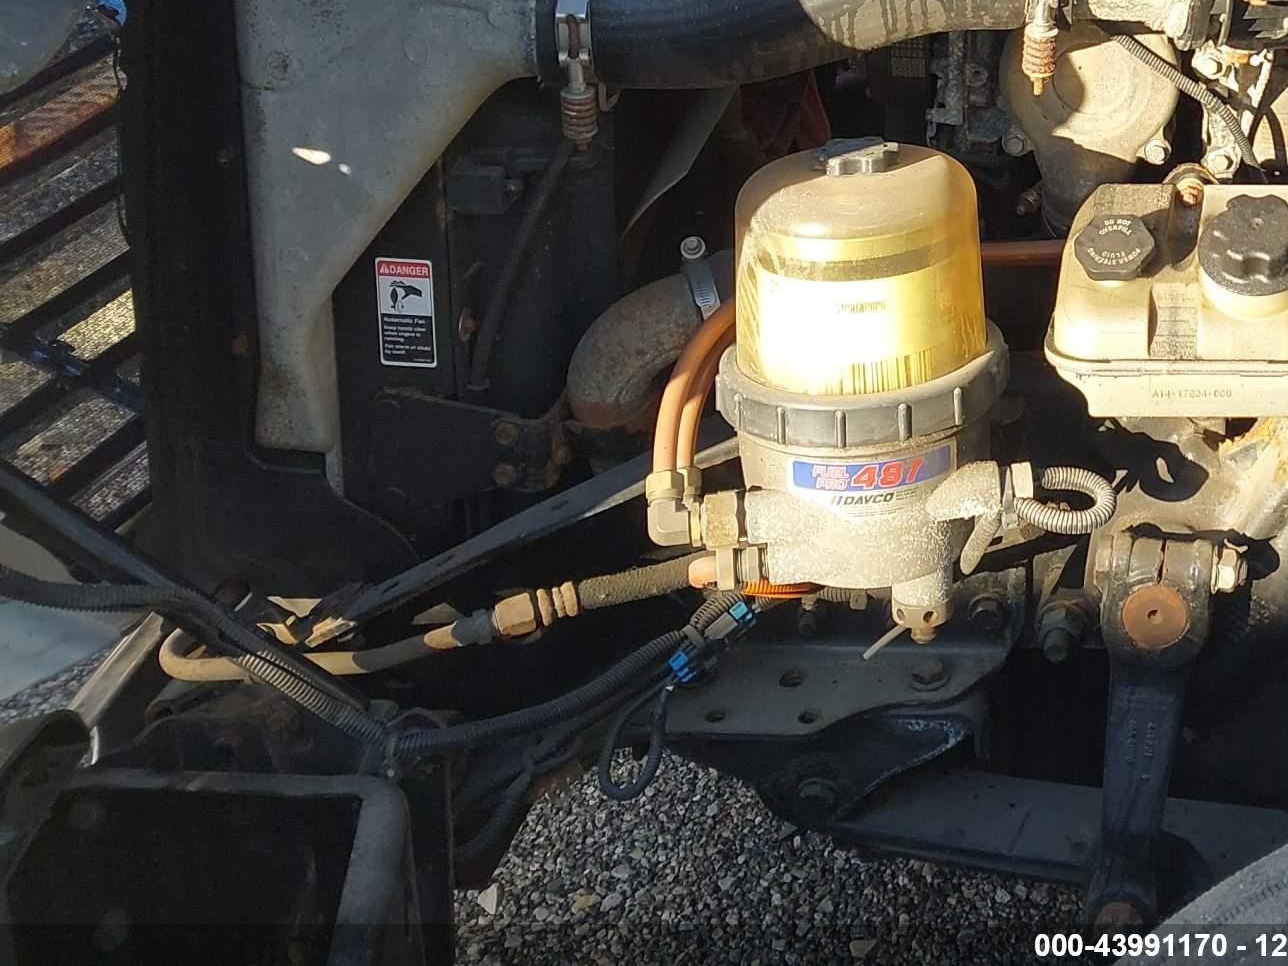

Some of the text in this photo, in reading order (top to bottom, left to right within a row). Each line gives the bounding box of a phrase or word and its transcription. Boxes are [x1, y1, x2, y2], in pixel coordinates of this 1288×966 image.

[1104, 218, 1132, 226] DO NOT
[1099, 224, 1132, 235] OVERFILL
[389, 264, 429, 276] DANGER
[811, 465, 850, 479] FUEL
[850, 457, 925, 490] 481
[816, 477, 848, 491] PRO
[843, 492, 894, 506] DAVCO
